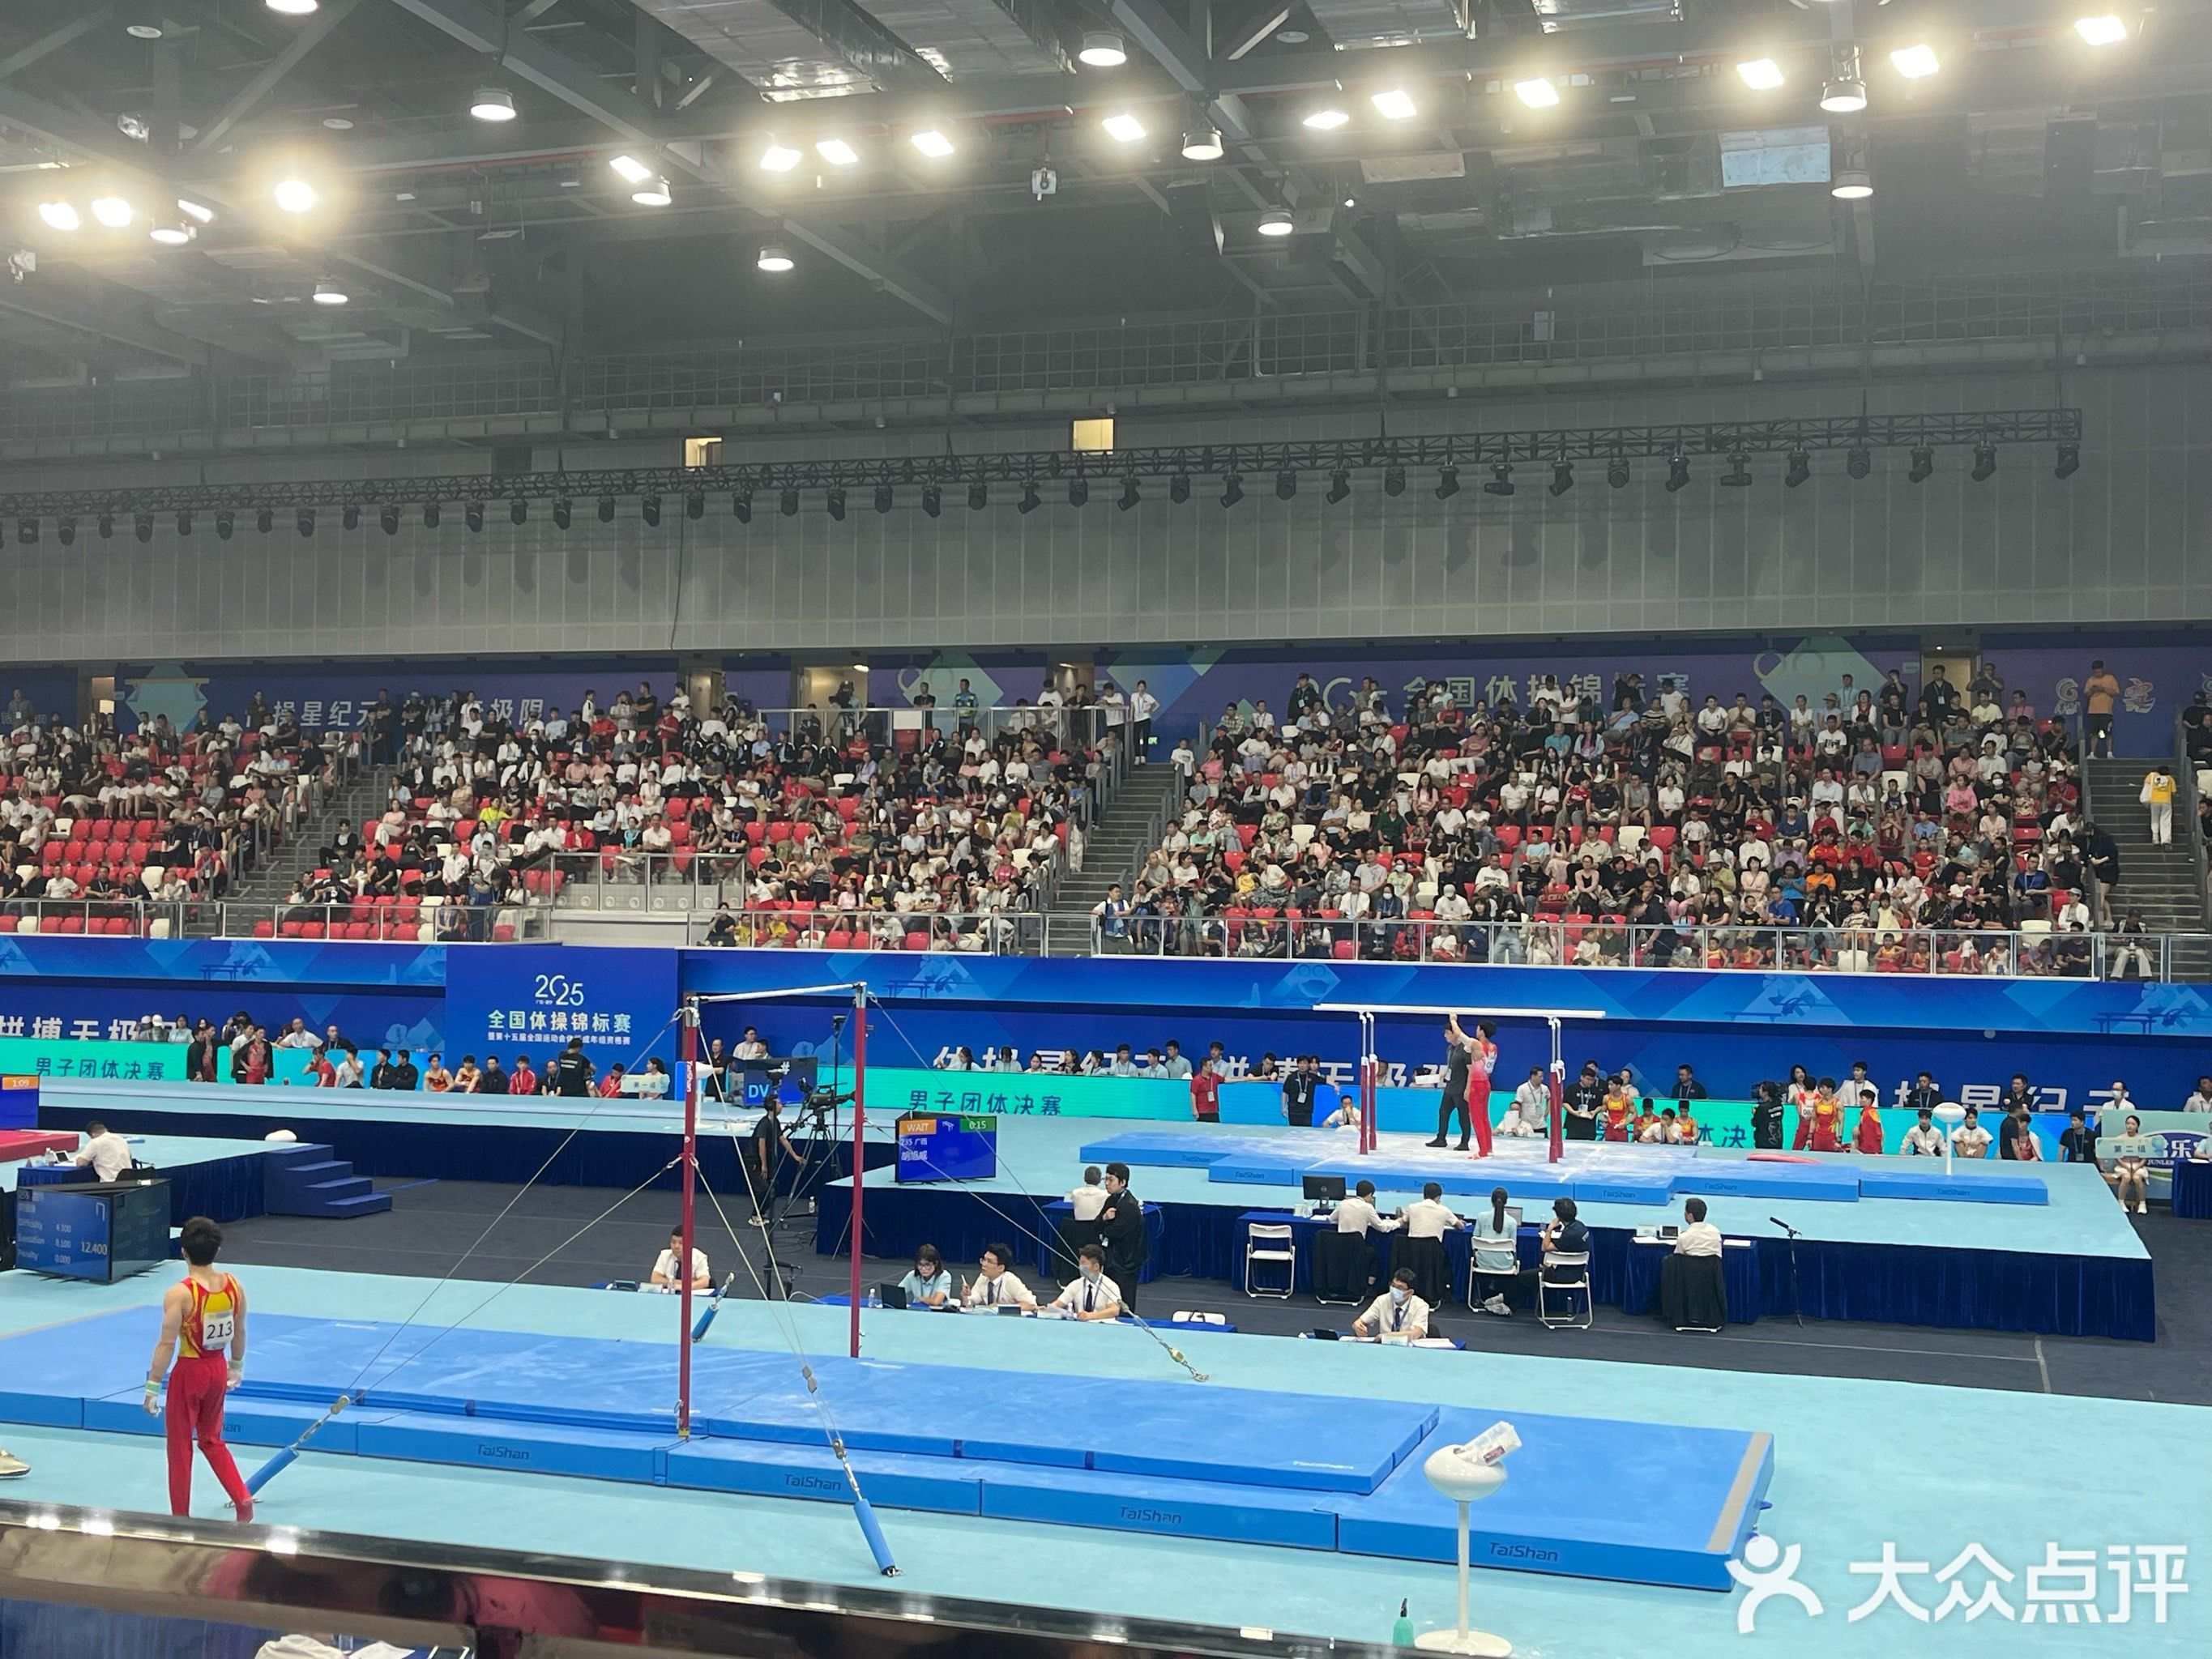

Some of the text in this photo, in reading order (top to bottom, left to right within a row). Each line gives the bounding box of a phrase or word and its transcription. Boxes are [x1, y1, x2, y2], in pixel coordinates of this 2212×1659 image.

[535, 975, 584, 1006] 2025
[488, 1010, 631, 1034] 全国体操锦标赛
[36, 1057, 164, 1080] 男子团体决赛
[12, 1079, 30, 1088] 1:09
[748, 1084, 770, 1098] DV
[909, 1090, 1062, 1115] 男子团体决赛
[907, 1123, 929, 1132] WAIT
[968, 1121, 987, 1130] 0:15
[80, 1241, 108, 1256] 12.400
[207, 1320, 233, 1340] 213
[476, 1444, 530, 1461] TaiShan
[784, 1473, 842, 1492] TaiShan
[1118, 1504, 1184, 1525] TaiShan
[1488, 1541, 1560, 1563] TaiShan
